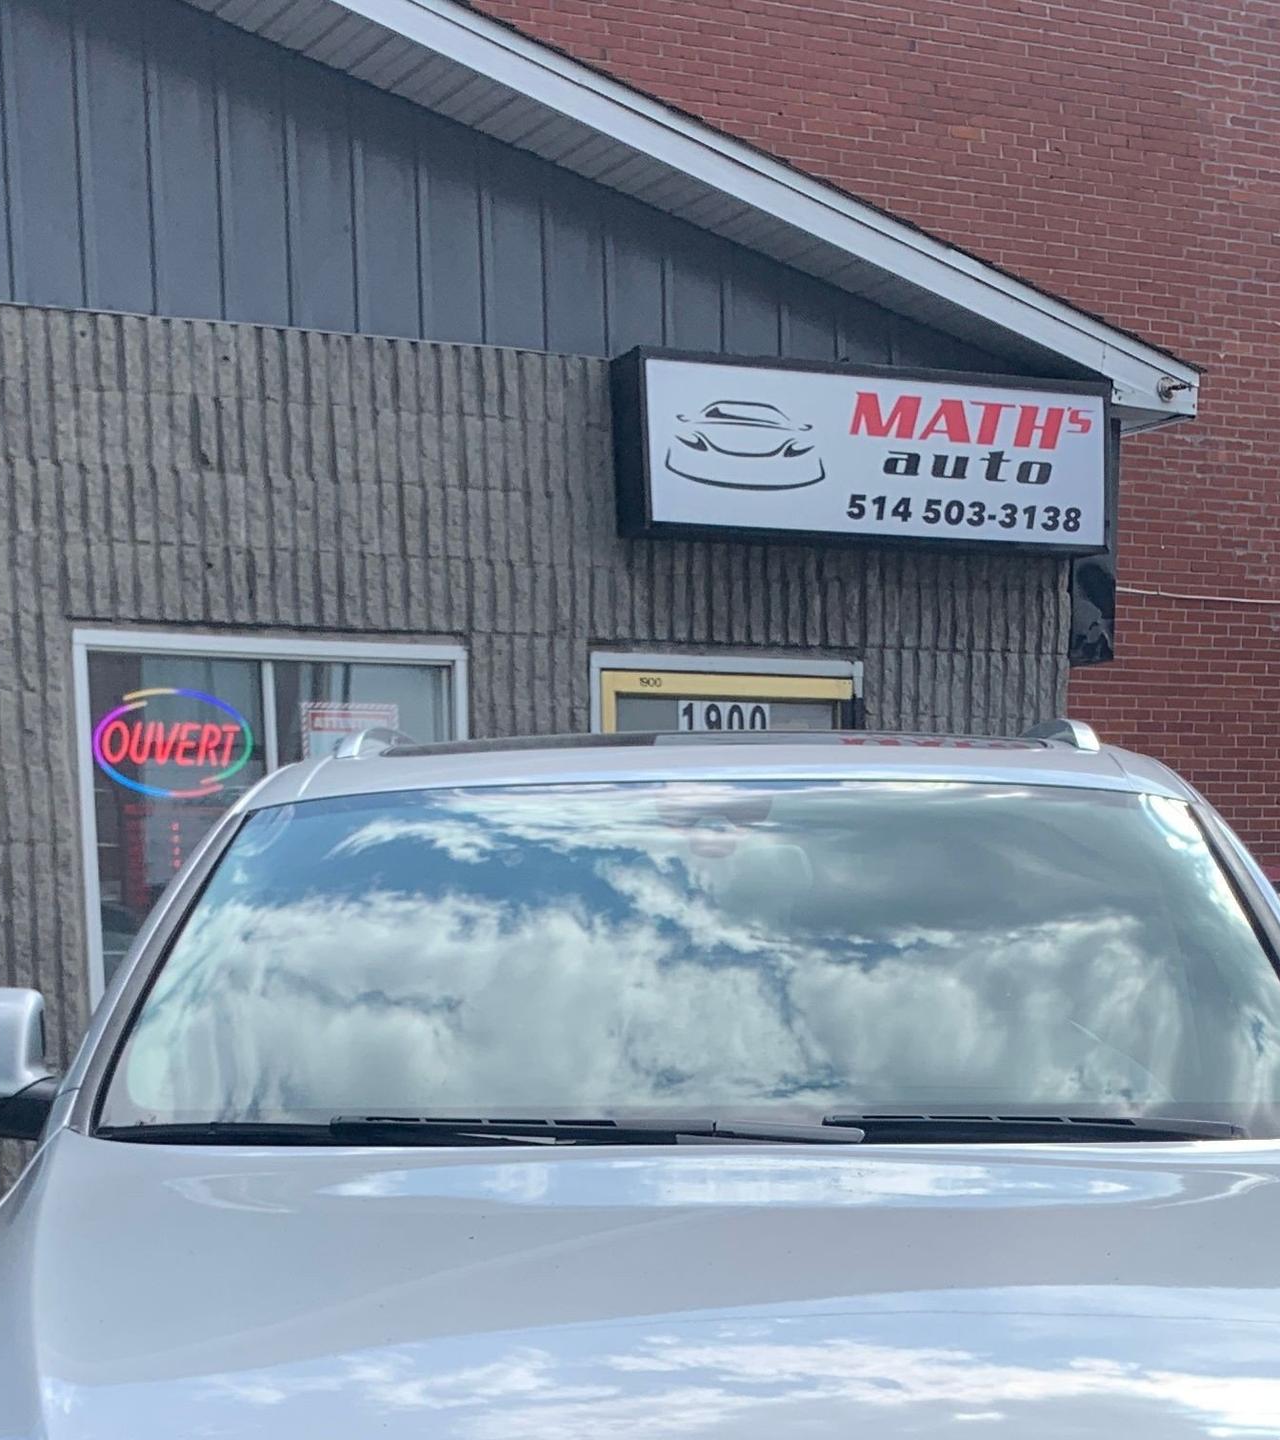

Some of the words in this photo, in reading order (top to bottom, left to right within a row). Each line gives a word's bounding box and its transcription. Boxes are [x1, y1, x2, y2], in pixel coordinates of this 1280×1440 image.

[882, 450, 1053, 485] auto
[846, 493, 912, 523] 514
[922, 498, 1082, 533] 503-3138
[102, 720, 241, 767] OUVERT
